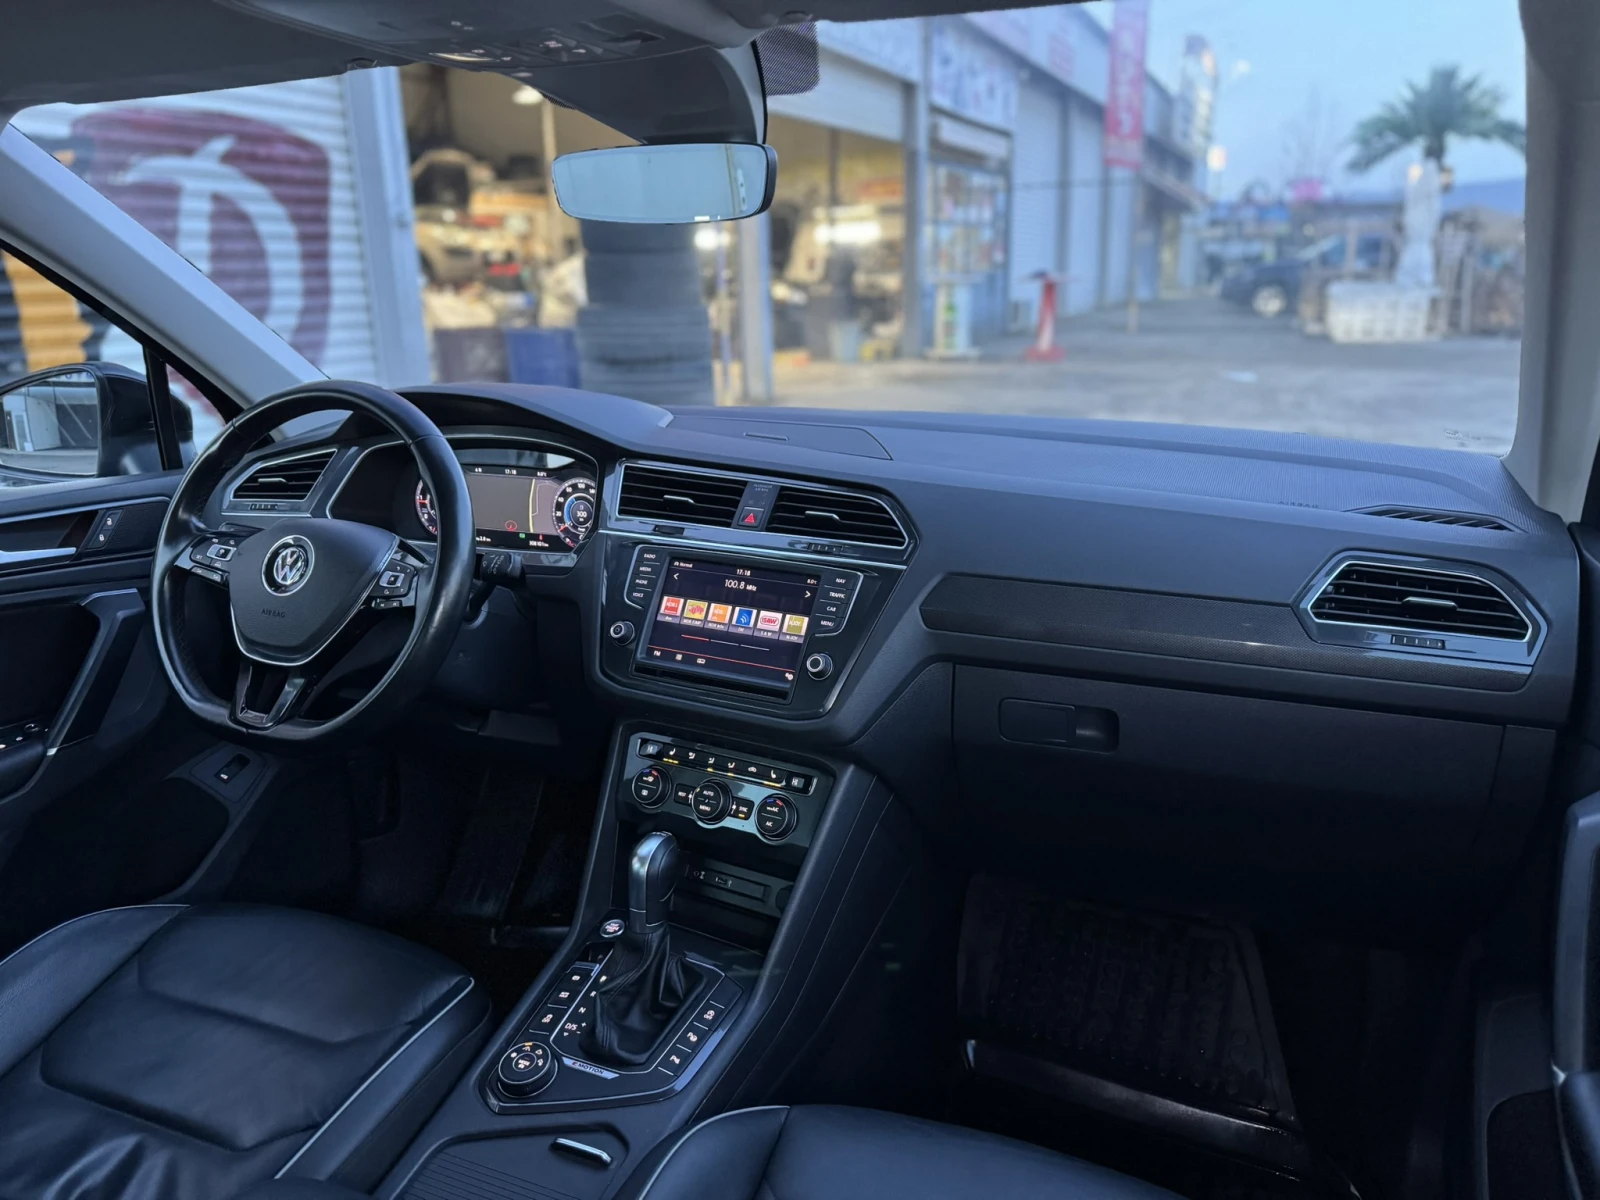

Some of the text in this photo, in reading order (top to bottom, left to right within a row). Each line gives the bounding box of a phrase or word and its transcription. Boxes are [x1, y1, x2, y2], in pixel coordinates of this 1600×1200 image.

[724, 579, 745, 590] 100.8
[829, 591, 846, 599] TRAFFIC
[261, 608, 286, 619] AIRBAG
[699, 804, 711, 812] MENU
[564, 1022, 579, 1031] D/S
